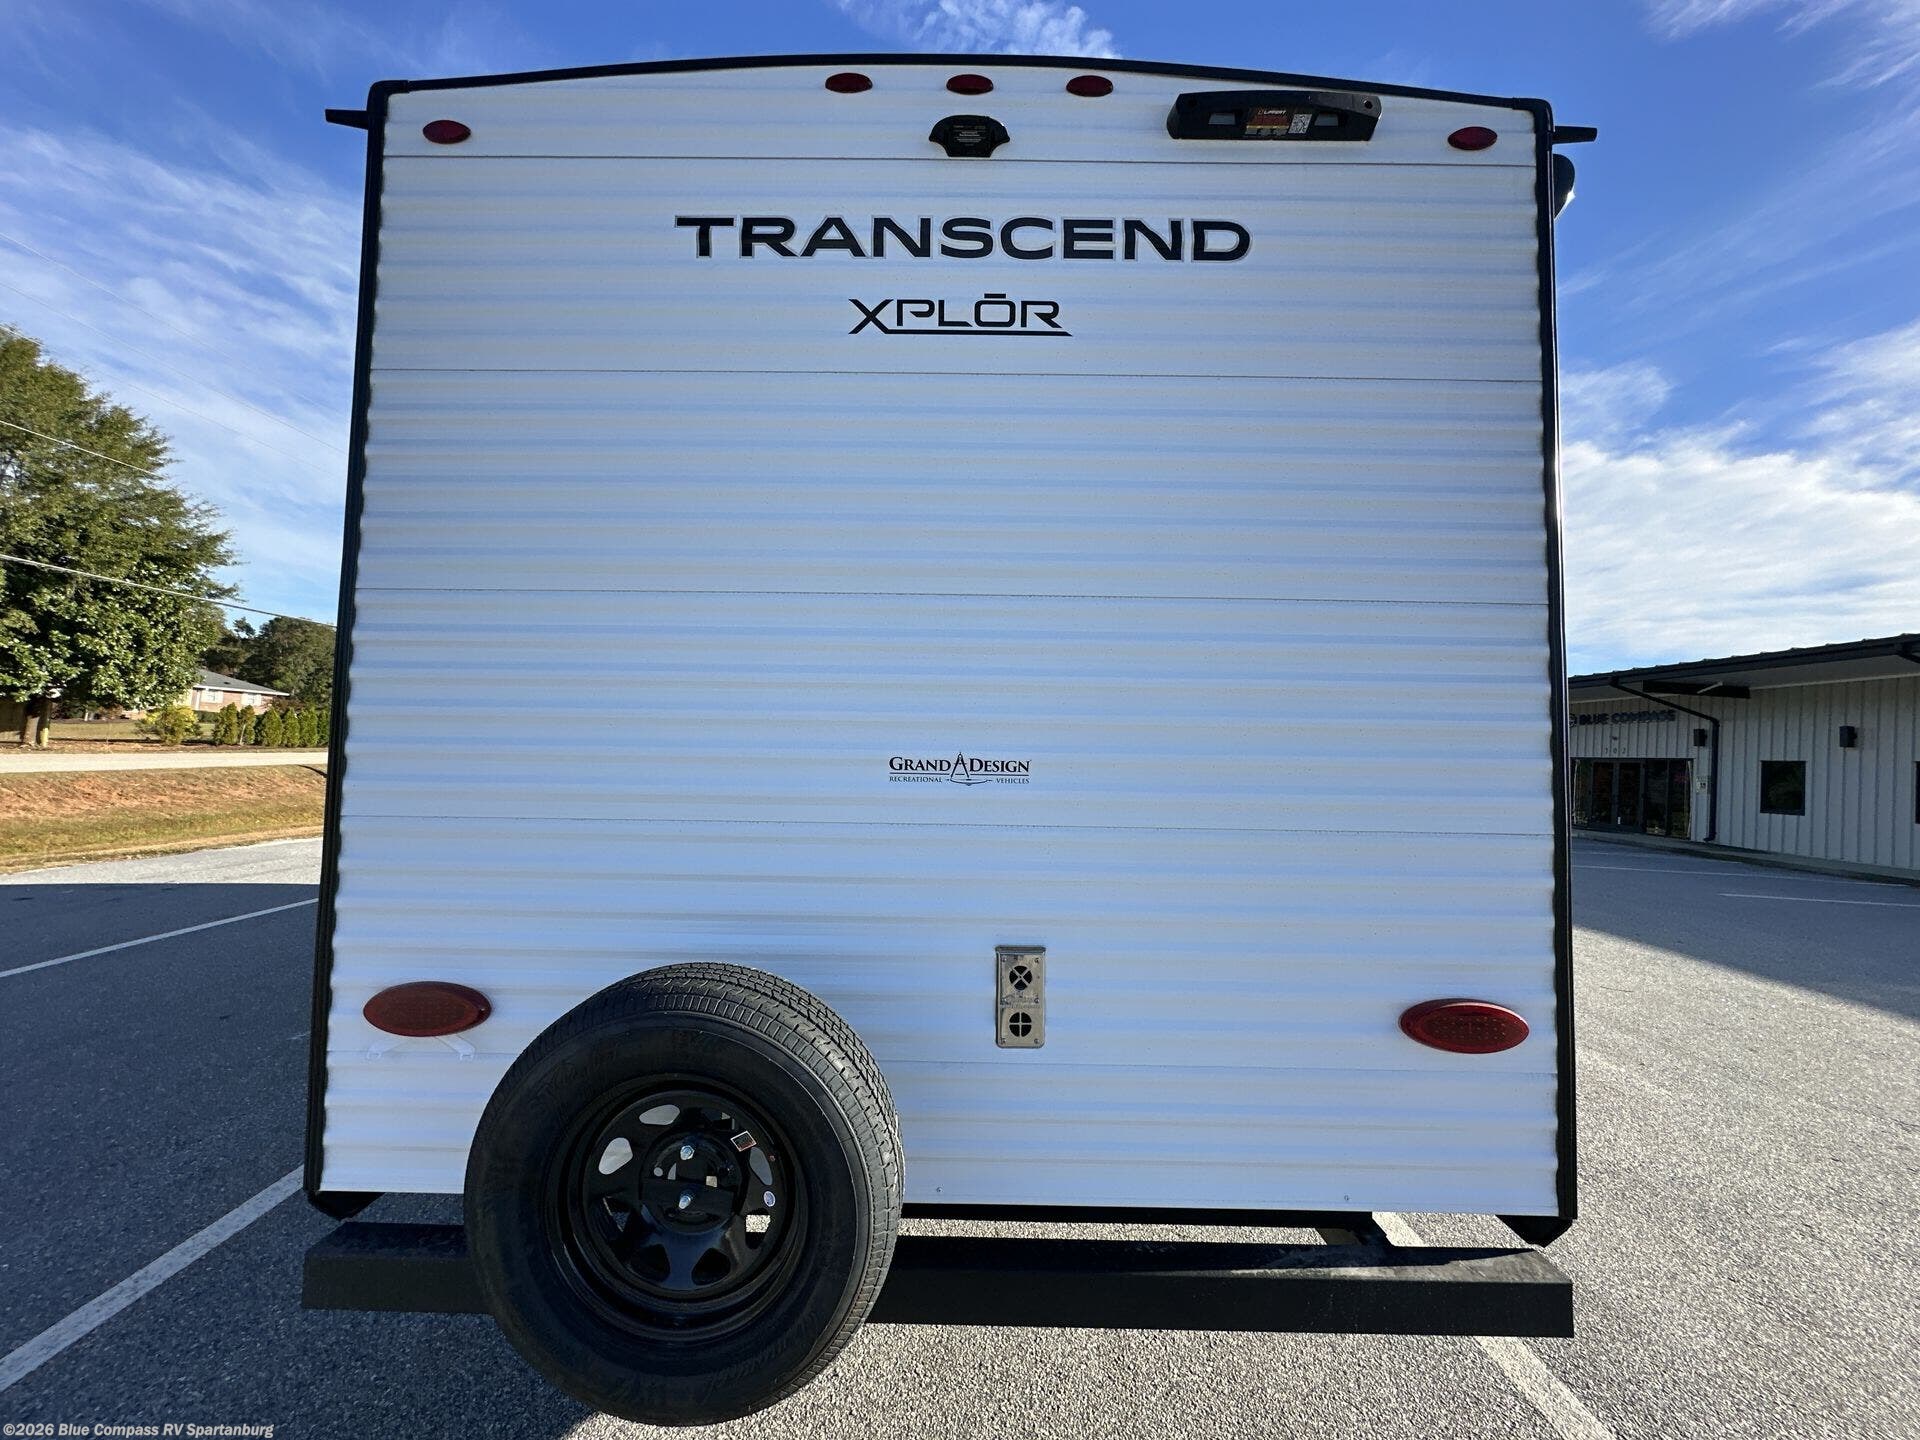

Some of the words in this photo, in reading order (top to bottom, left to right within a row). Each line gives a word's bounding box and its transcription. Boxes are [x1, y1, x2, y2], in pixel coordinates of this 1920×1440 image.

[675, 215, 1253, 262] TRANSCEND
[889, 756, 952, 772] GRAND
[969, 758, 1030, 773] DESIGN
